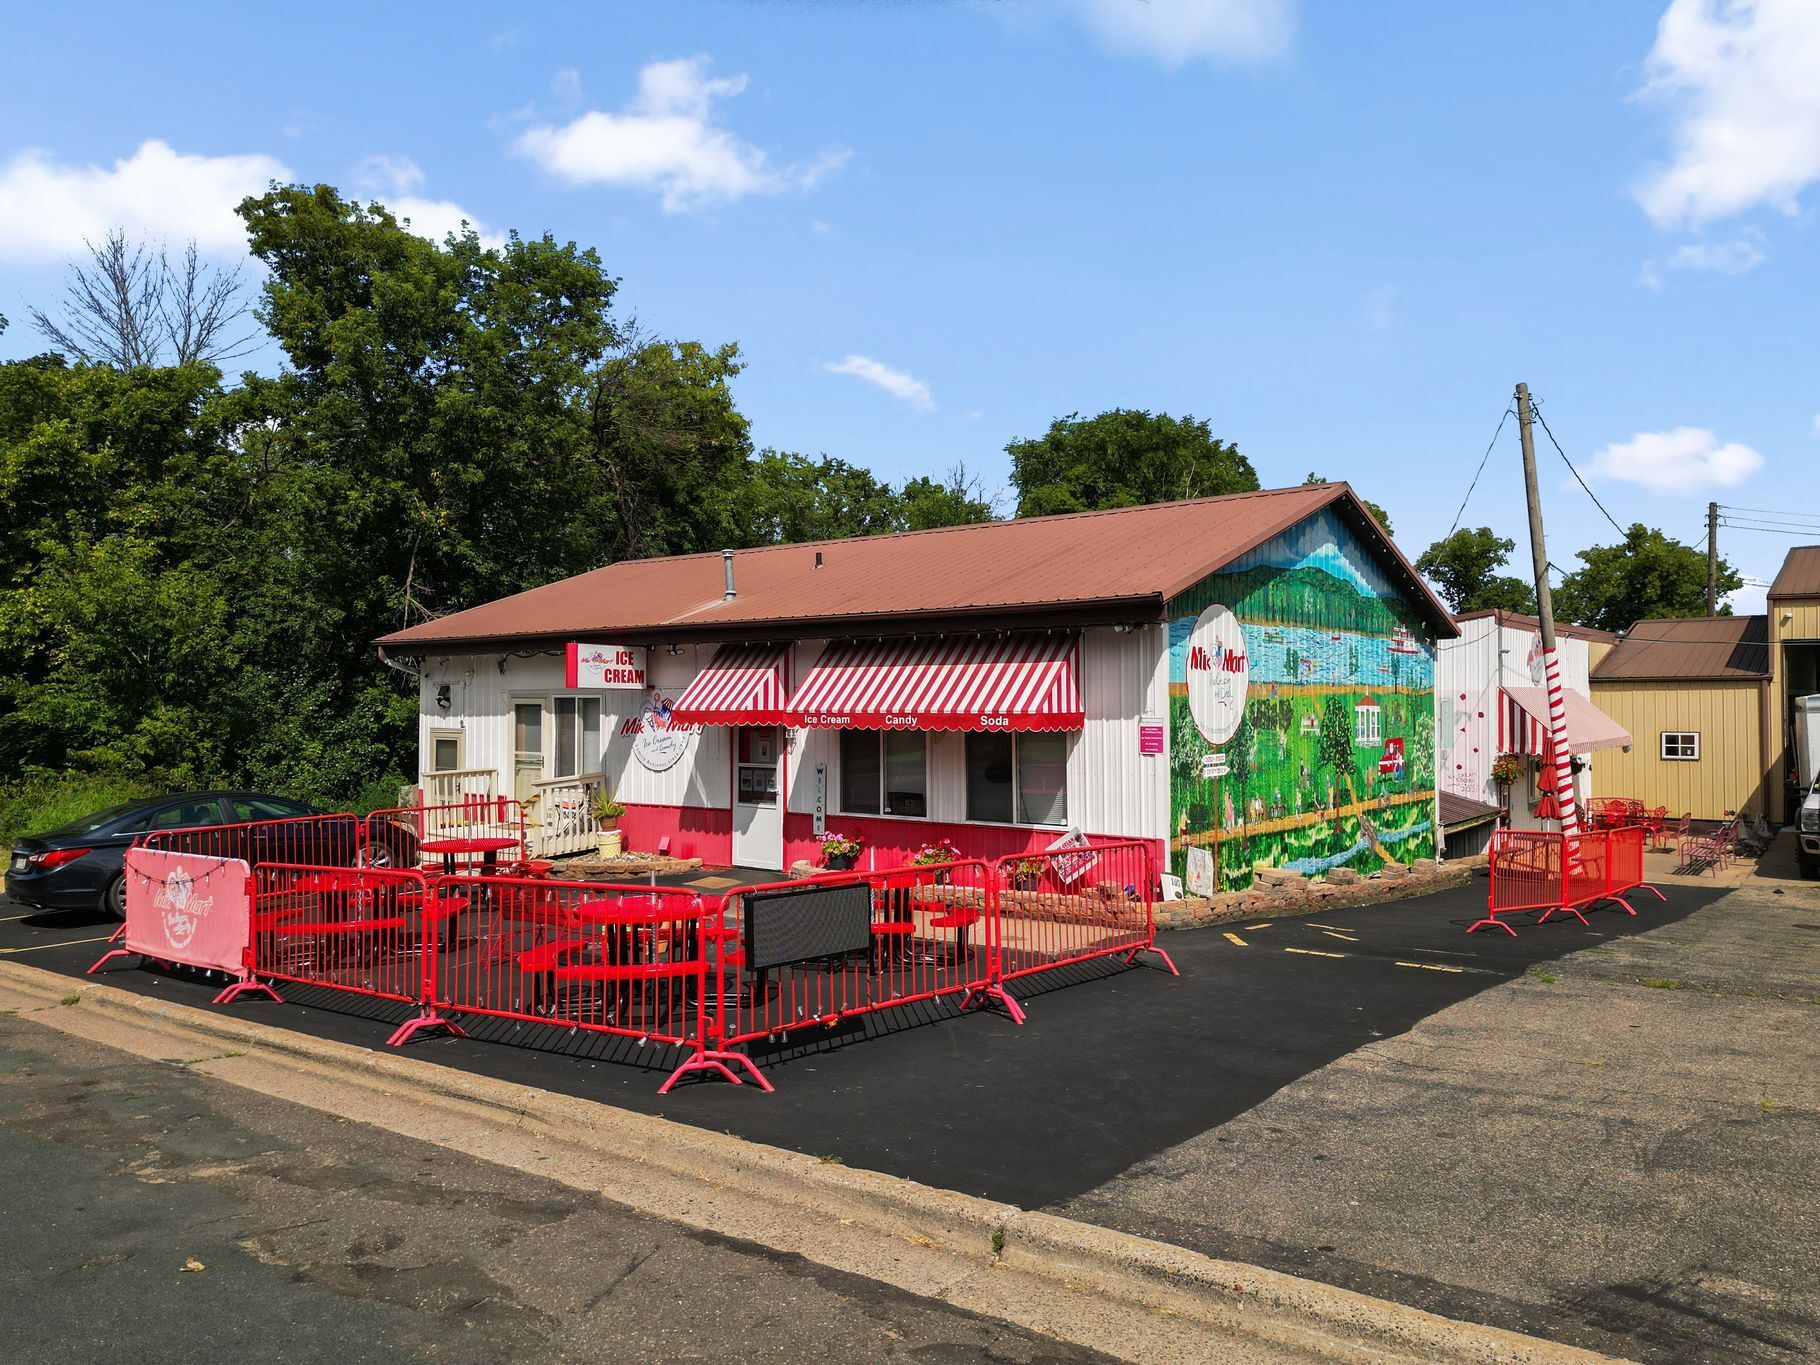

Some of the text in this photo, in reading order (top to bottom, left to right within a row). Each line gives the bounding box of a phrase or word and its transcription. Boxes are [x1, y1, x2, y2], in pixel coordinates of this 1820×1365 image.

[615, 651, 634, 666] ICE
[604, 668, 645, 684] CREAM
[620, 717, 645, 736] Mik
[804, 714, 850, 724] Ice Cream
[885, 714, 918, 727] Candy
[980, 715, 1009, 726] Soda
[815, 767, 824, 832] WELCOME
[184, 892, 214, 917] Mart
